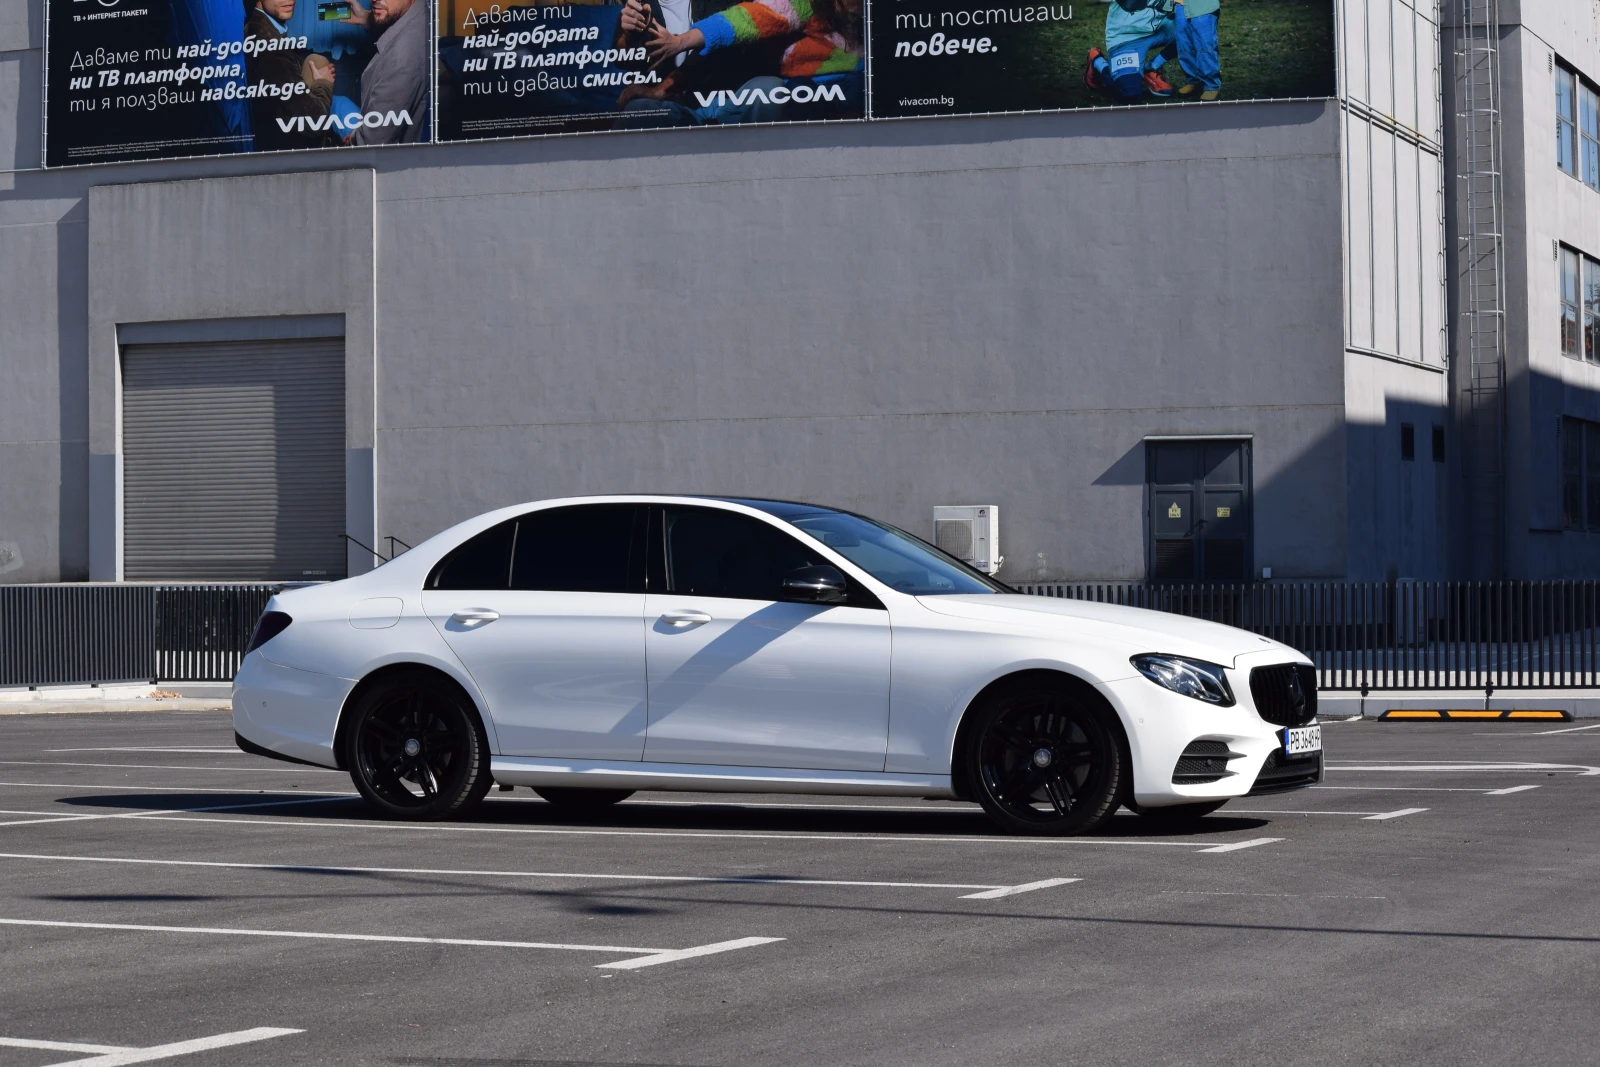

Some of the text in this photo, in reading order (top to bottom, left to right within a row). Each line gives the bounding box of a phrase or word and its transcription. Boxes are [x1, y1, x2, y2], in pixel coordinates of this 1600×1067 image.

[87, 11, 120, 21] ИНТЕРНЕТ
[121, 8, 148, 18] ПАКЕТИ
[463, 4, 572, 29] Даваме ти
[896, 4, 1073, 29] ти постигаш
[463, 25, 599, 50] най-добрата
[894, 32, 998, 58] повече.
[70, 34, 308, 72] Даваме ти най-добрата
[463, 45, 651, 72] ни ТВ платформа,
[1116, 56, 1134, 67] 055
[69, 63, 246, 90] ни ТВ платформа,
[463, 80, 492, 96] ти
[513, 71, 578, 98] даваш
[582, 69, 663, 89] смисъл.
[70, 80, 311, 112] ти я ползваш навсякъде.
[692, 84, 847, 109] VIVACOM
[898, 95, 955, 107] vivacom.bg
[275, 109, 414, 134] VIVACOM
